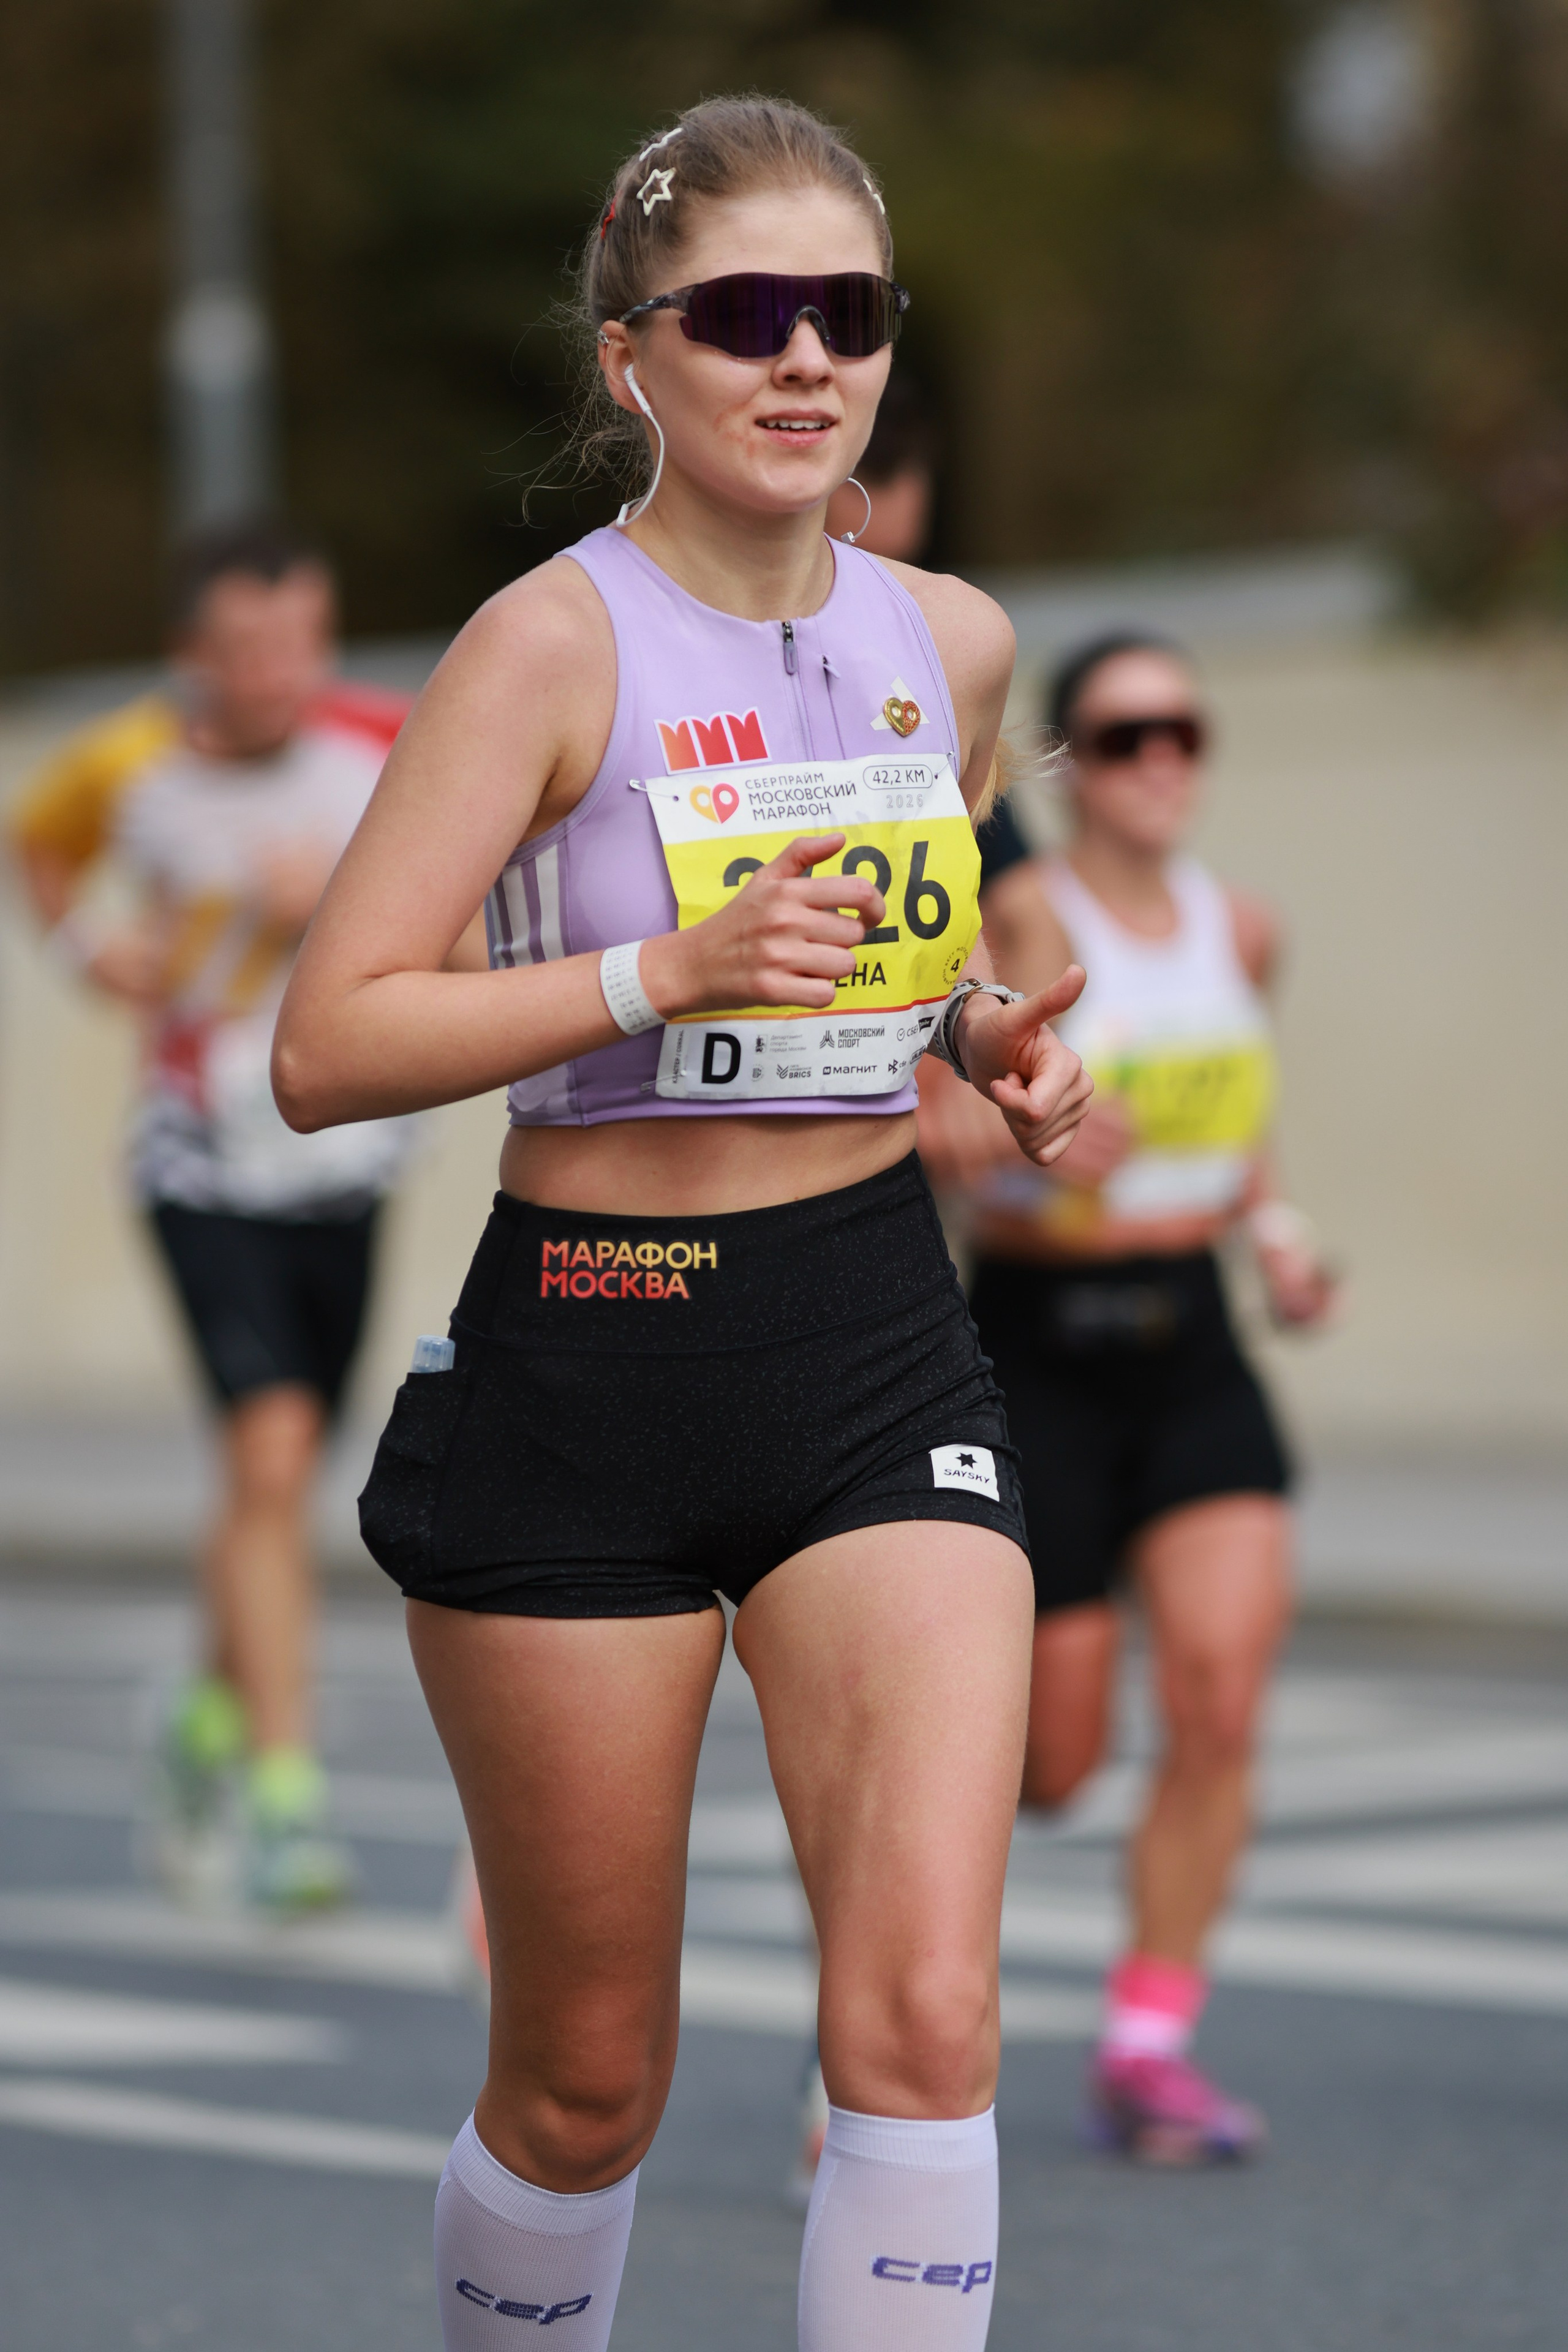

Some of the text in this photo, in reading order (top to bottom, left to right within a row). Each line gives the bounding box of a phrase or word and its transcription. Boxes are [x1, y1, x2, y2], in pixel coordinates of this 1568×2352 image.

[745, 772, 824, 790] СБЕРПРАЙМ
[873, 769, 925, 785] 42,2 КМ
[748, 781, 857, 805] МОСКОВСКИЙ
[886, 794, 924, 809] 2026
[752, 802, 831, 821] МАРАФОН
[951, 959, 960, 972] 4
[838, 1025, 884, 1038] МОСКОВСКИЙ
[838, 1039, 860, 1048] СПОРТ
[701, 1033, 741, 1084] D
[833, 1066, 877, 1074] магнит
[542, 1241, 717, 1269] МАРАФОН
[540, 1271, 690, 1299] МОСКВА
[944, 1469, 990, 1483] SAYSKY
[872, 2256, 992, 2293] cep
[456, 2278, 592, 2325] cep
